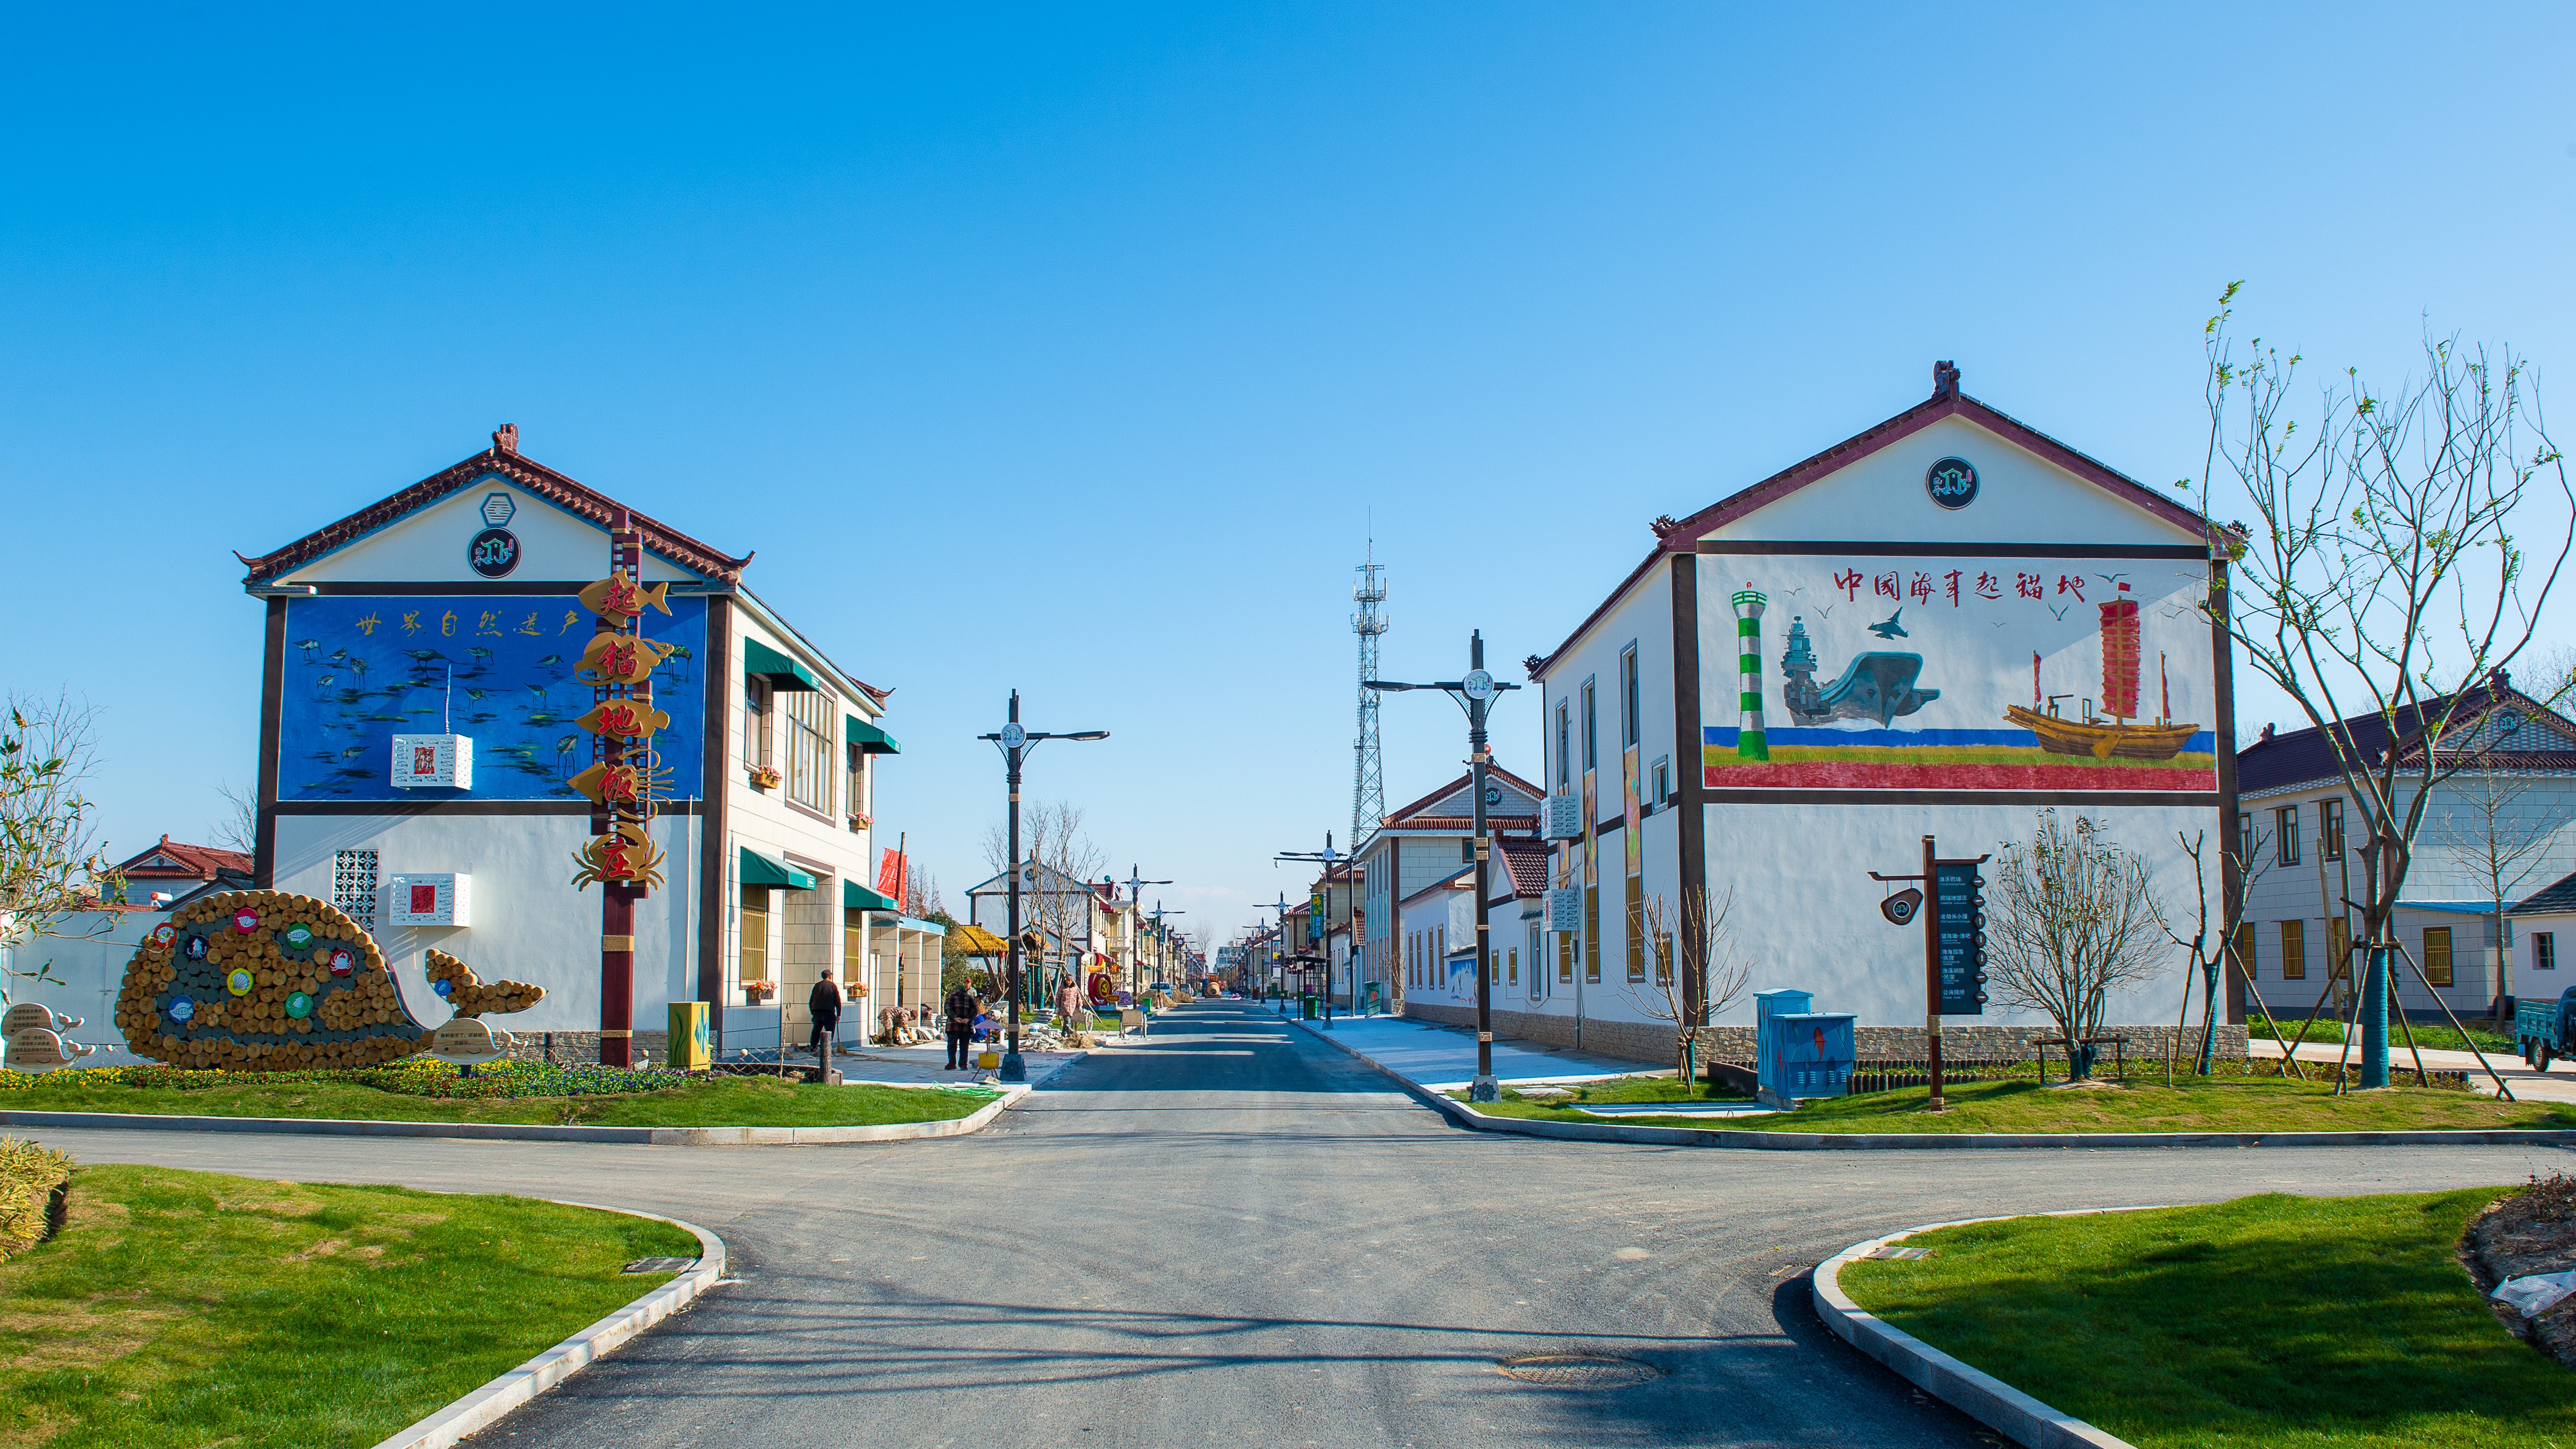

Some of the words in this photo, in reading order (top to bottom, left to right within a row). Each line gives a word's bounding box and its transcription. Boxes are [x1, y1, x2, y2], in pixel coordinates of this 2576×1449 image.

[355, 609, 579, 637] 世界自然遗产
[595, 577, 645, 881] 起锚地饭庄
